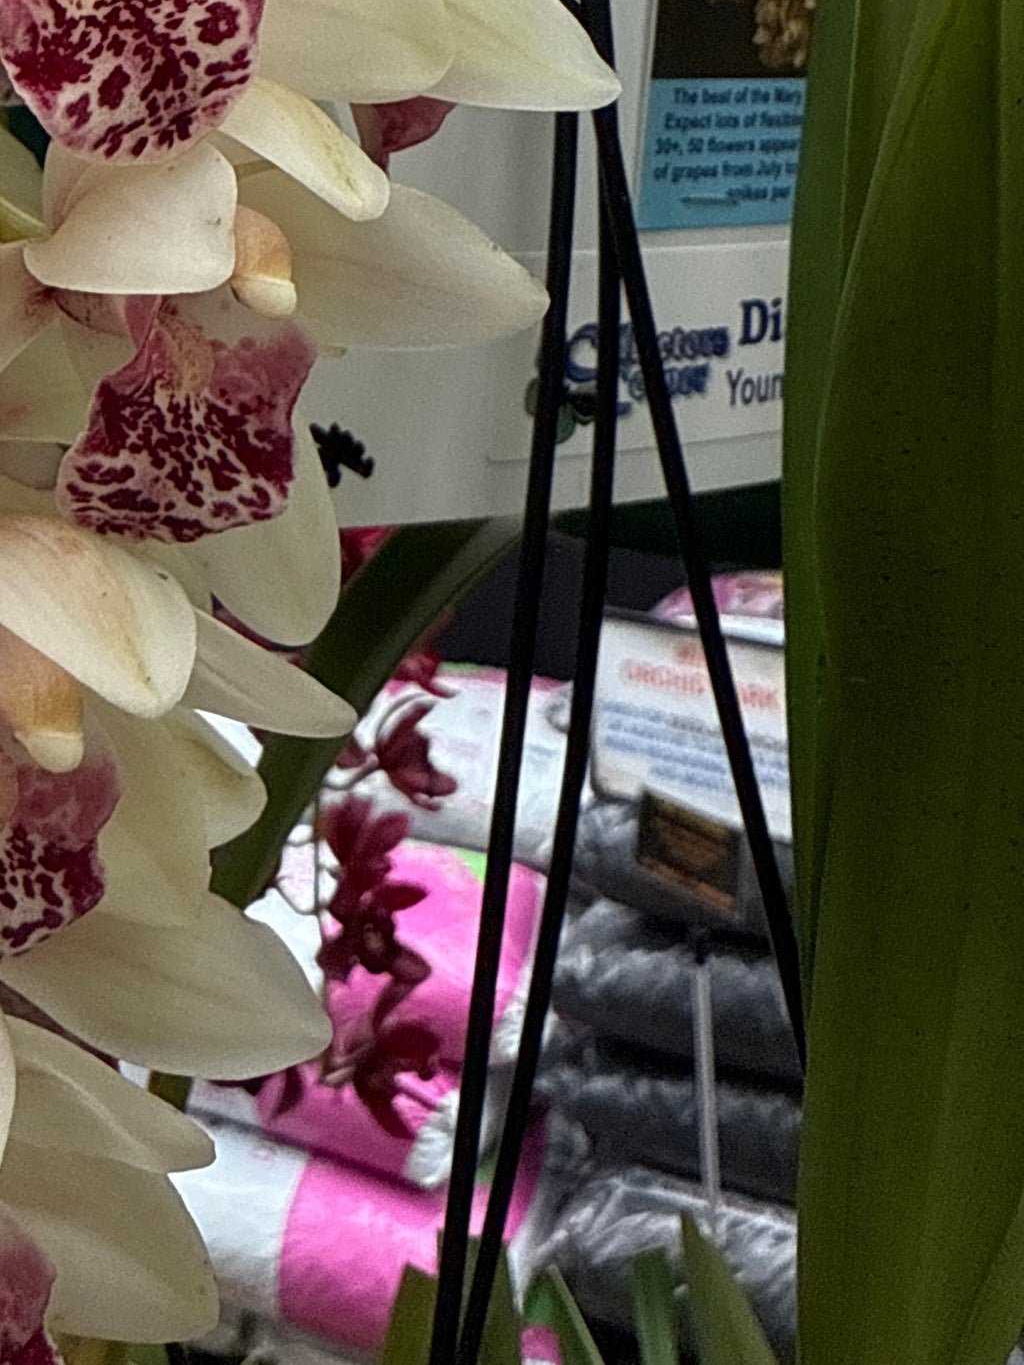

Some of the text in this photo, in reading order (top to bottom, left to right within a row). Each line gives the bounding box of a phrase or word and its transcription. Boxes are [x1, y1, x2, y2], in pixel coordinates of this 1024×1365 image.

[674, 87, 698, 104] The
[734, 87, 749, 103] of
[751, 87, 770, 104] the
[664, 112, 711, 131] Expect
[653, 161, 669, 180] of
